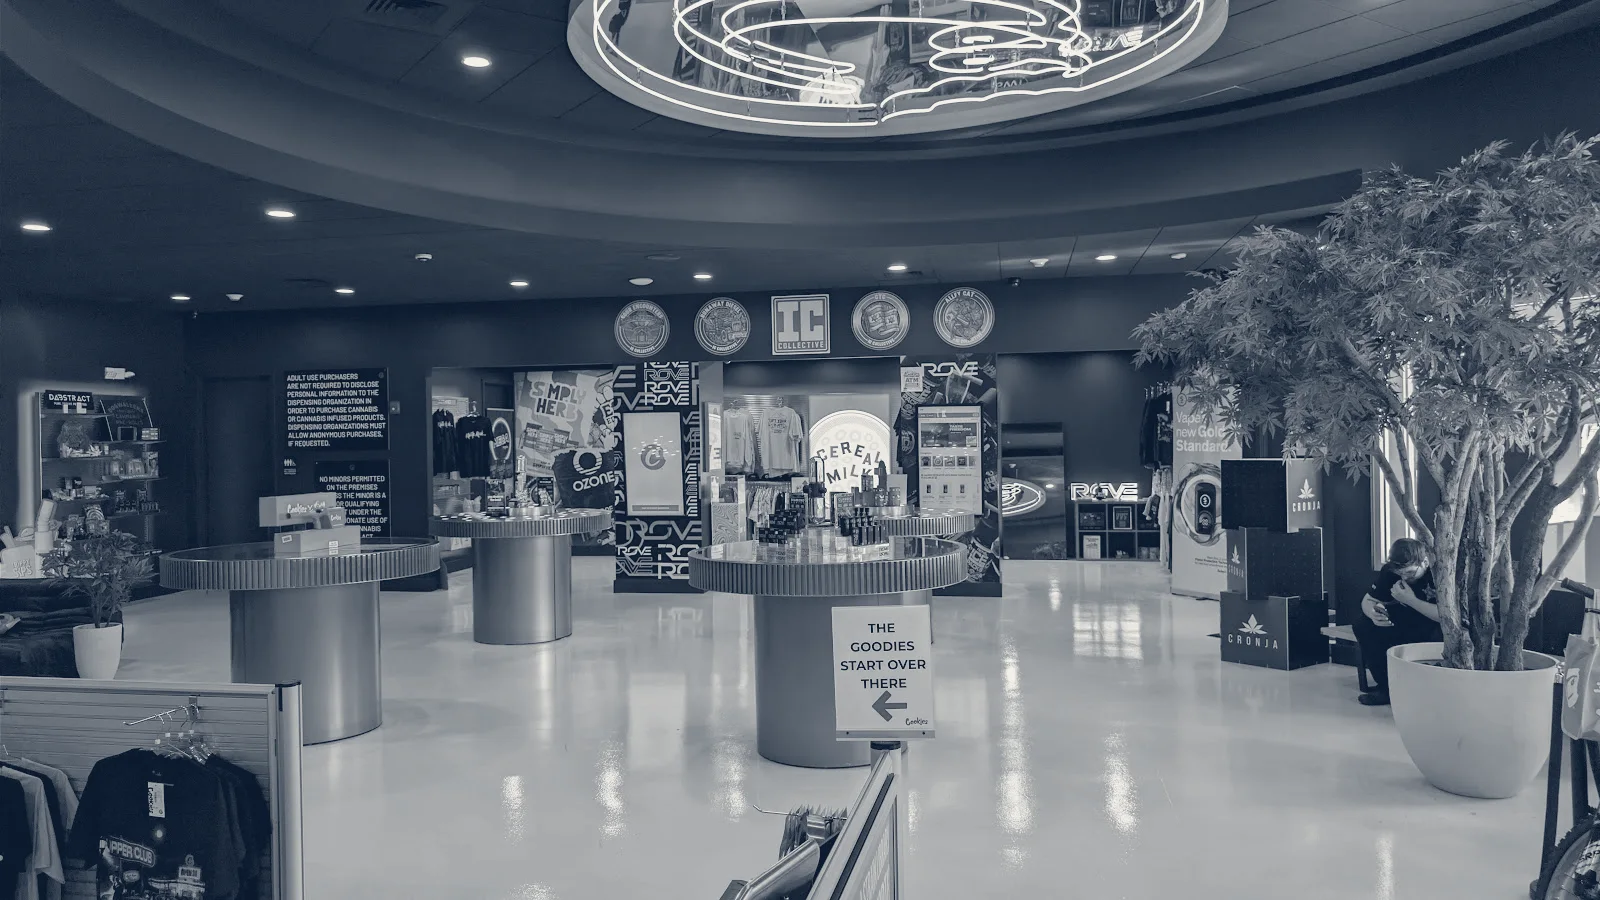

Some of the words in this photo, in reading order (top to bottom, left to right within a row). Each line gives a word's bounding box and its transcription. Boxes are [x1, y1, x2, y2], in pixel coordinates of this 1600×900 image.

[944, 291, 961, 304] ALLEY
[778, 301, 824, 342] IC
[778, 341, 824, 350] COLLECTIVE
[644, 369, 689, 382] ROVE
[921, 362, 978, 376] ROVE
[645, 382, 689, 394] ROVE
[48, 393, 91, 402] DABSTRACT
[645, 394, 689, 406] ROVE
[536, 398, 575, 419] HERB
[1176, 428, 1197, 438] new
[1197, 425, 1227, 438] Gold
[1176, 439, 1232, 452] Standard.
[816, 441, 881, 466] CEREAL
[826, 464, 873, 485] MILK
[572, 471, 615, 492] OZONE
[1070, 482, 1138, 501] ROVE
[1292, 501, 1321, 513] CRONJA
[625, 521, 702, 541] ROVE
[617, 547, 652, 556] ROVE
[868, 623, 895, 633] THE
[850, 641, 915, 652] GOODIES
[1228, 633, 1279, 650] CRONJA
[840, 660, 883, 671] START
[887, 659, 926, 670] OVER
[861, 678, 907, 689] THERE
[133, 846, 153, 864] CLUB
